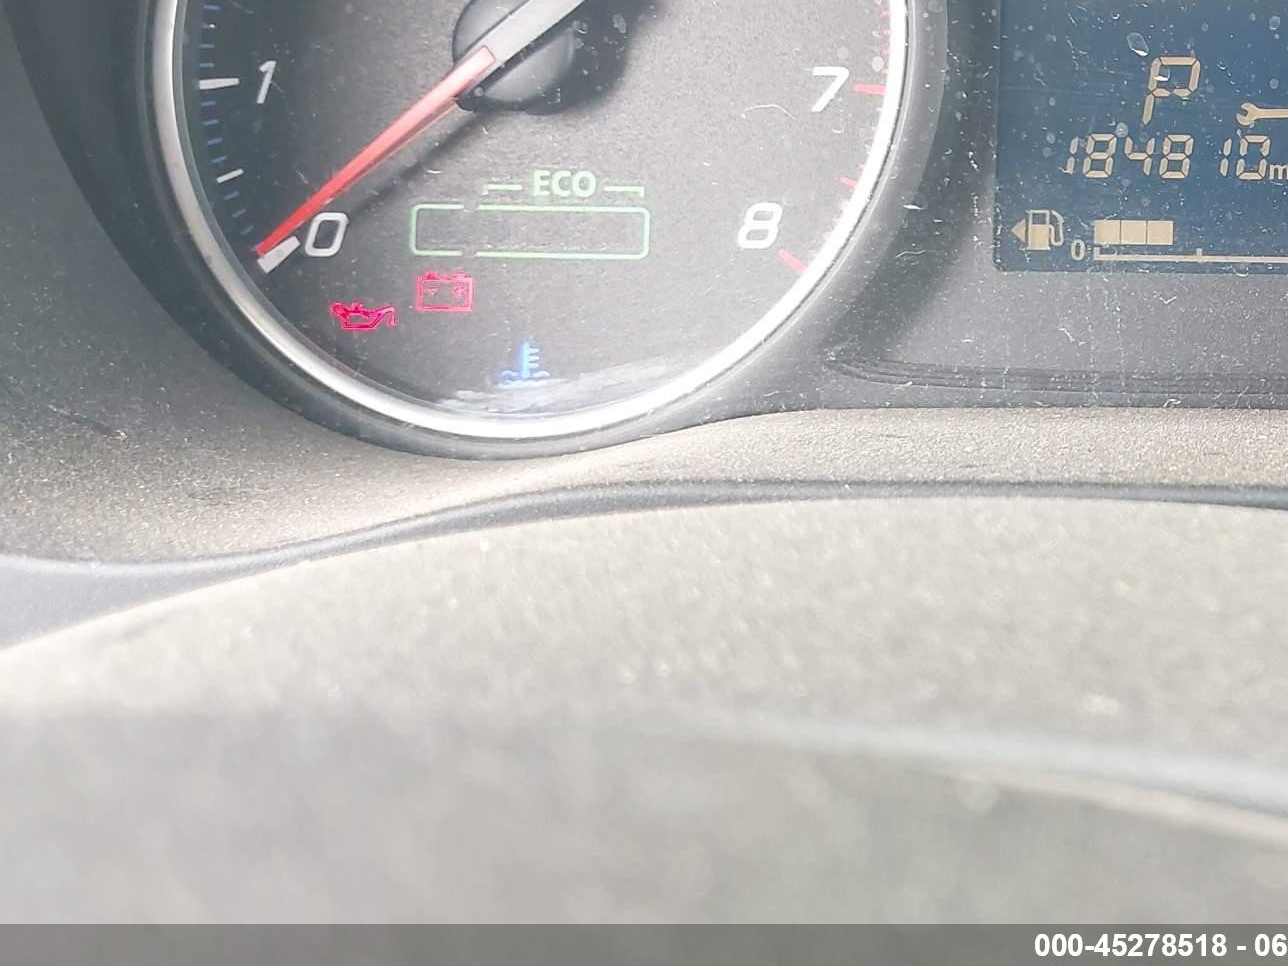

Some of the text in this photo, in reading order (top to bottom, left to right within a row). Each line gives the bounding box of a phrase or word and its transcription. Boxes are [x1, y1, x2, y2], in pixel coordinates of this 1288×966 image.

[257, 61, 277, 104] 1
[812, 68, 848, 112] 7
[1143, 57, 1200, 124] P
[532, 171, 597, 198] ECO
[305, 213, 348, 257] 0
[738, 203, 783, 249] 8
[1071, 239, 1086, 261] 0
